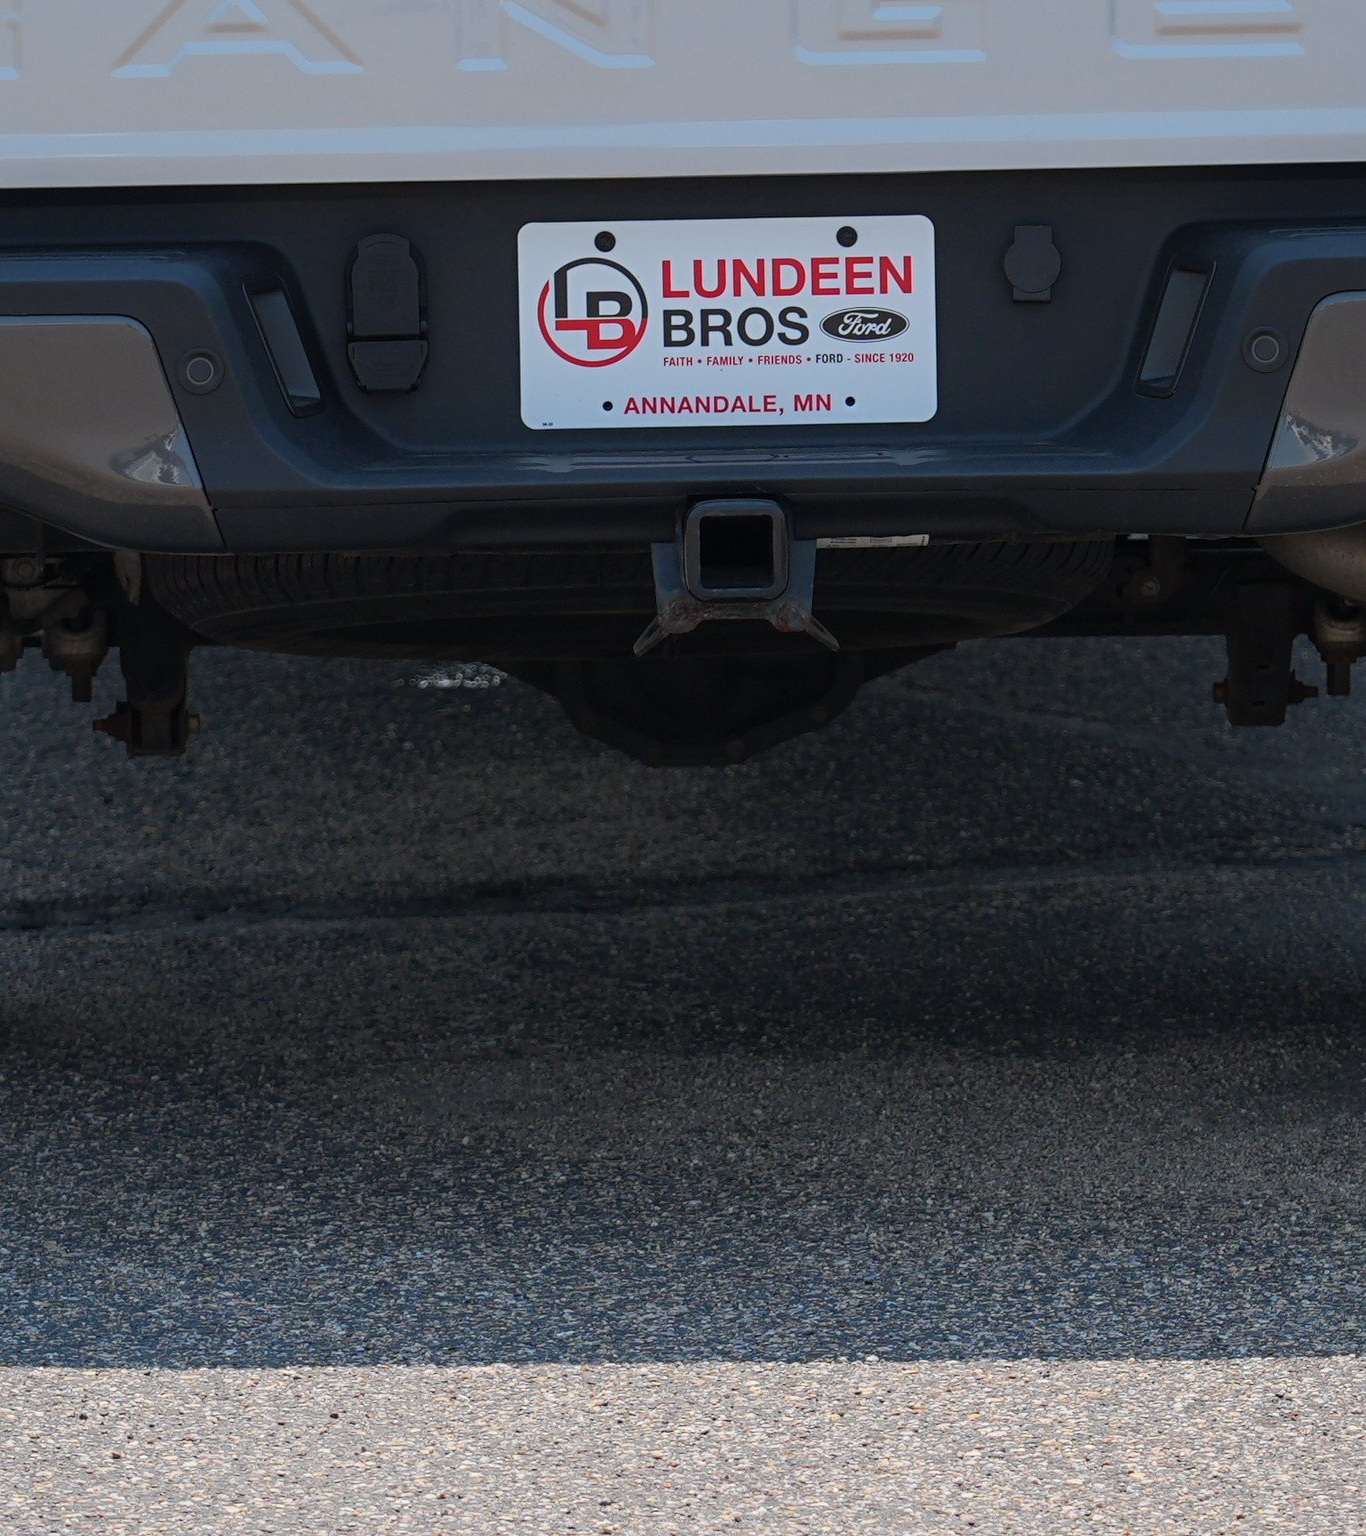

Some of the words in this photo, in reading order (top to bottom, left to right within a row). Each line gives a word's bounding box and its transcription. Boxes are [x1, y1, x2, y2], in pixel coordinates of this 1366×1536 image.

[662, 256, 913, 298] LUNDEEN
[663, 306, 810, 347] BROS
[663, 356, 694, 367] FAITH
[706, 355, 744, 366] FAMILY
[757, 354, 802, 365] FRIENDS
[815, 353, 843, 363] FORD
[854, 352, 886, 363] SINCE
[889, 352, 914, 363] 1920
[624, 394, 784, 416] ANNANDALE,
[794, 394, 832, 412] MN
